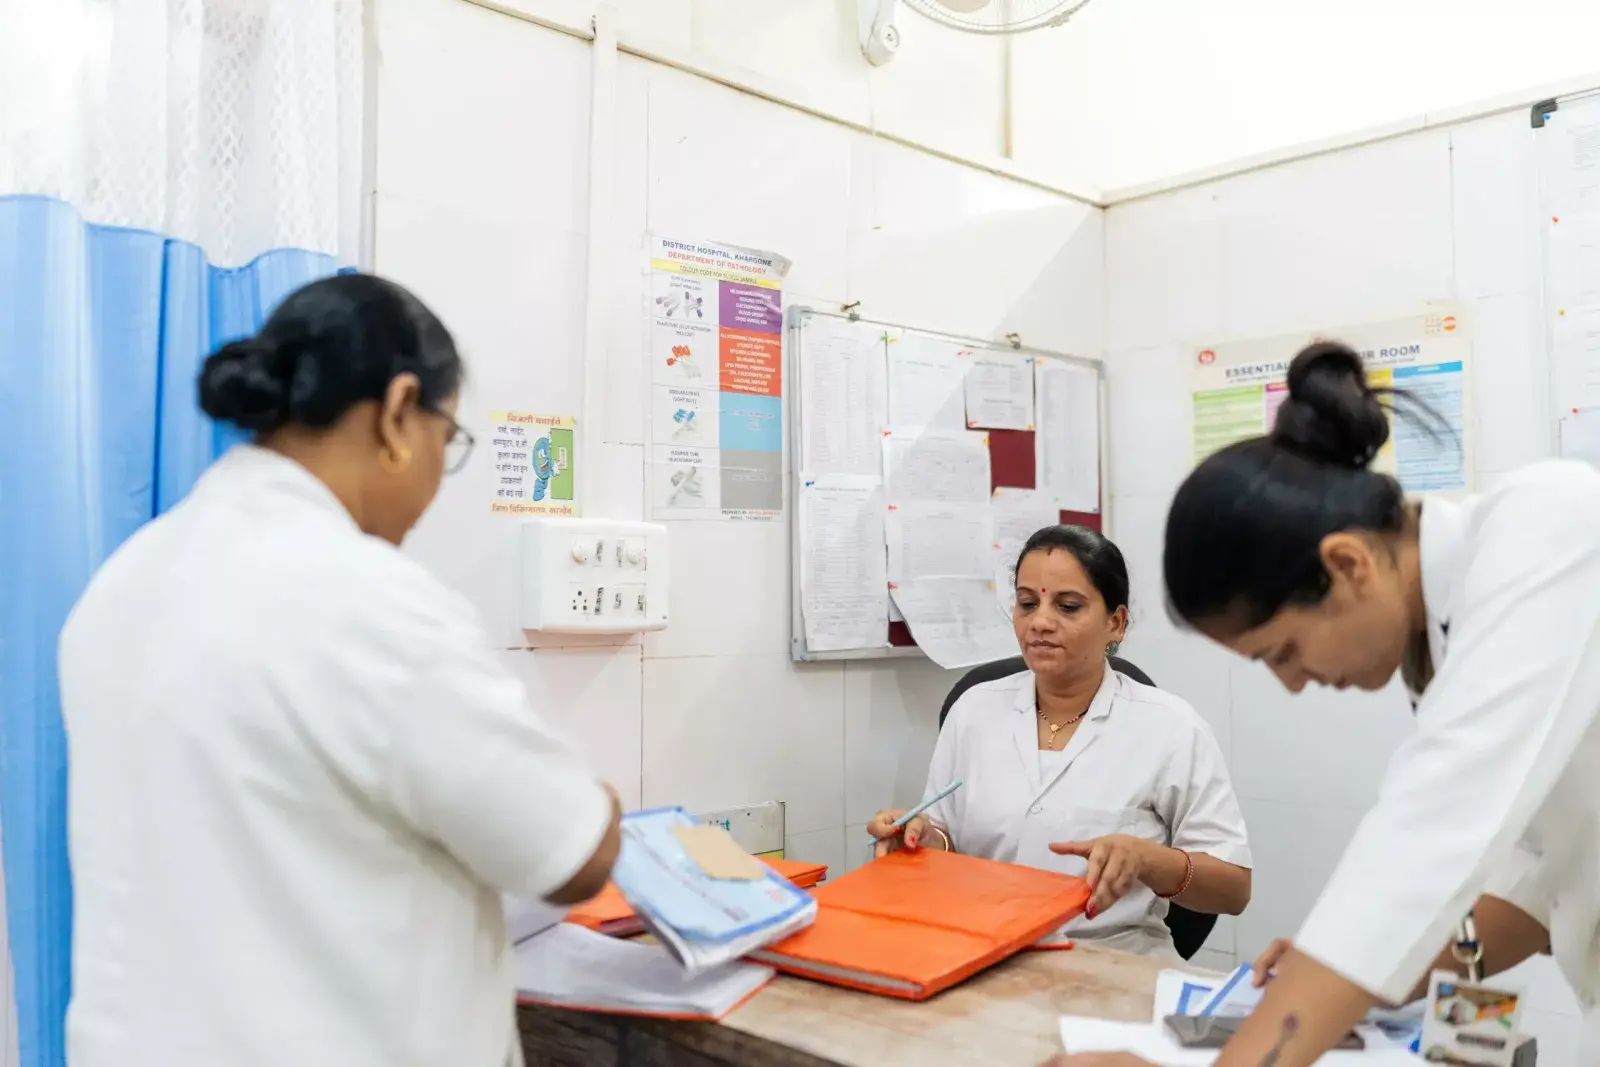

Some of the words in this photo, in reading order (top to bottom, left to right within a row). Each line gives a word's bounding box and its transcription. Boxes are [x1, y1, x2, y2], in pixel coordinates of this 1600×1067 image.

[662, 240, 696, 252] DISTRICT
[698, 246, 732, 260] HOSPITAL,
[734, 254, 772, 267] KHARGONE
[668, 251, 715, 266] DEPARTMENT
[716, 260, 726, 268] OF
[727, 262, 766, 275] PATHOLOGY
[680, 265, 699, 274] COLOUR
[700, 268, 712, 276] CODE
[1226, 361, 1290, 378] ESSENTIAL
[1380, 344, 1420, 358] ROOM
